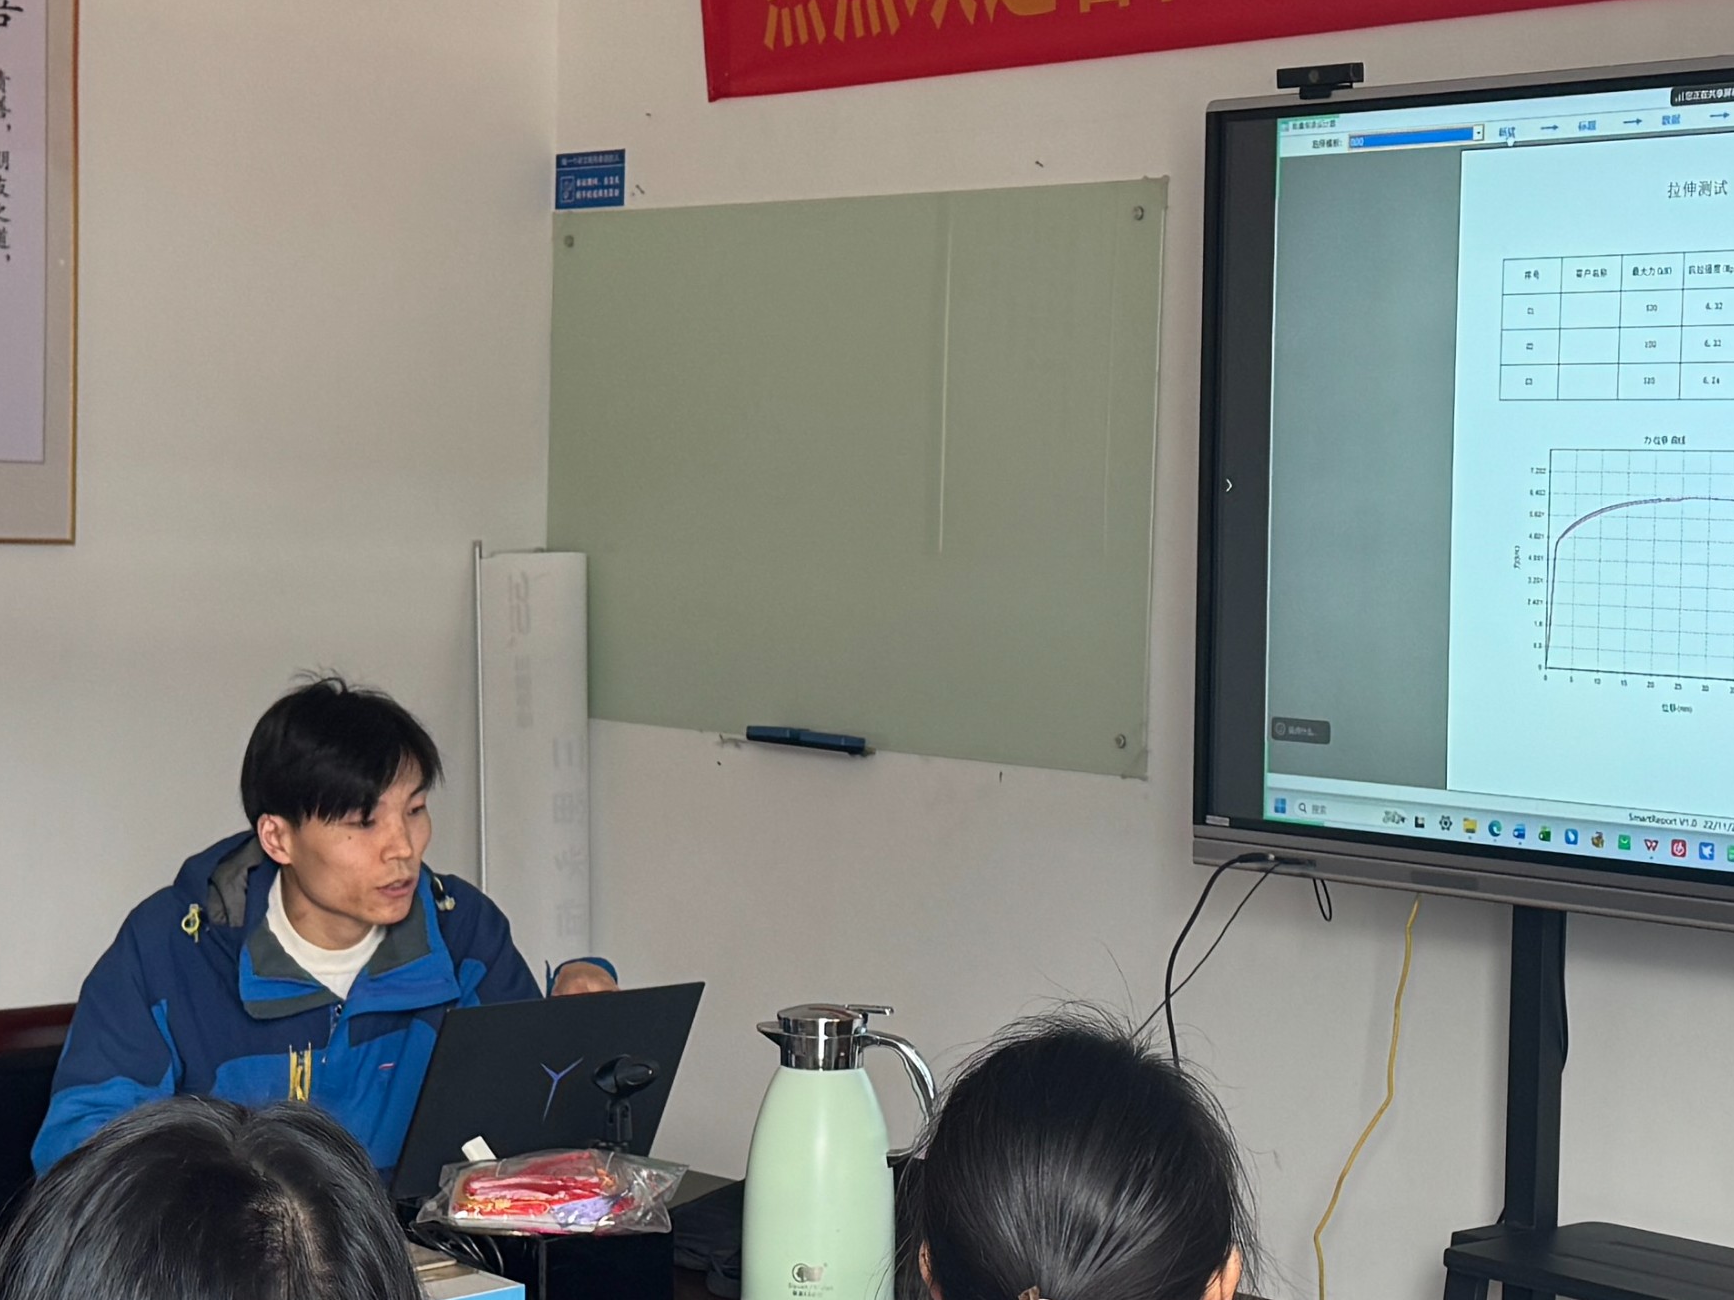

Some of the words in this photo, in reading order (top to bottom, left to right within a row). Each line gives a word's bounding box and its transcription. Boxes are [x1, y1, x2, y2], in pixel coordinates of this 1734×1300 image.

[1667, 179, 1729, 199] 拉伸测试
[1628, 811, 1678, 827] SmartReport
[1679, 818, 1698, 828] V1.0
